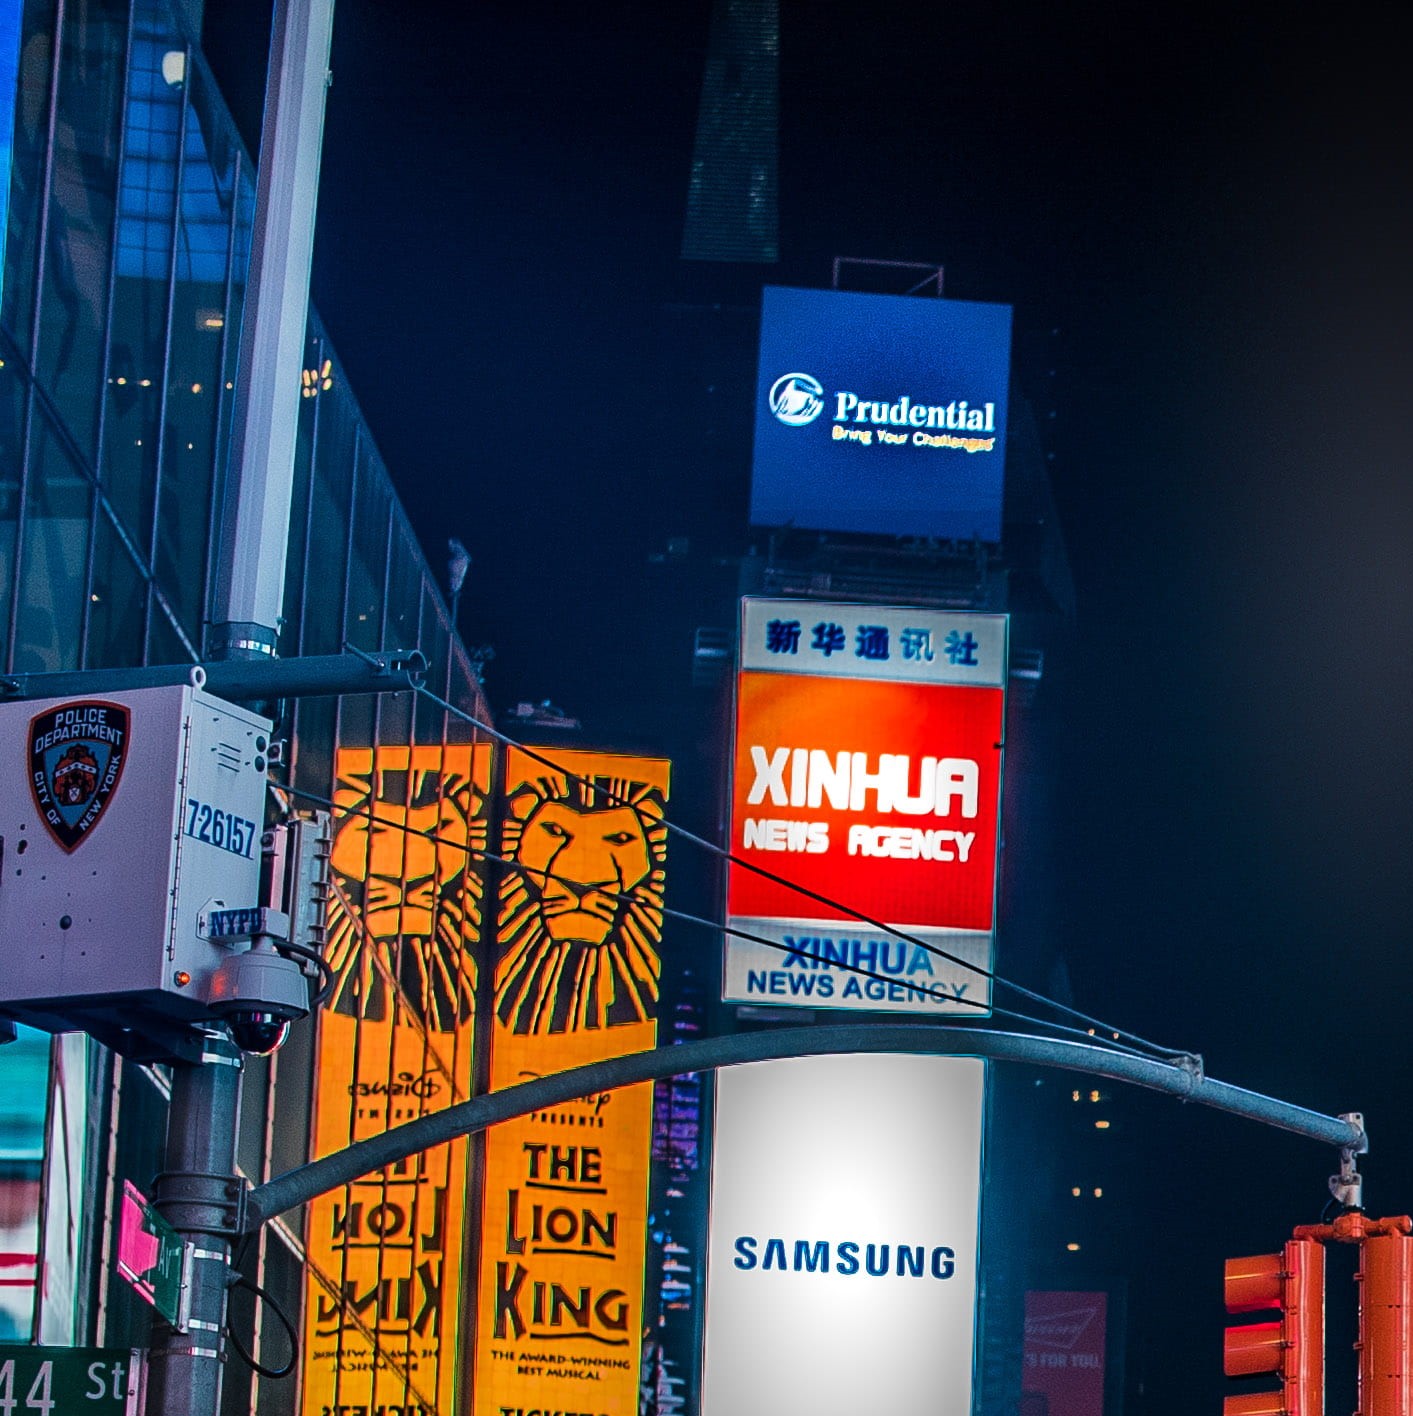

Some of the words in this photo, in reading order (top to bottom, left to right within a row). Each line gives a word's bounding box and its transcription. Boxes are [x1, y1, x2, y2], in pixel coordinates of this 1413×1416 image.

[833, 391, 995, 432] Prudential
[832, 425, 873, 446] Bring
[877, 429, 909, 445] Your
[765, 618, 980, 668] 新华通讯社
[55, 708, 108, 726] POLICE
[35, 722, 123, 754] DEPARTMENT
[34, 771, 50, 804] CITY
[47, 809, 62, 826] OF
[79, 801, 102, 832] NEW
[101, 753, 122, 795] YORK
[747, 745, 980, 819] XINHUA
[742, 817, 830, 856] NEWS
[847, 823, 976, 863] AGENCY
[210, 908, 264, 937] NYPD
[780, 933, 935, 977] XINHUA
[746, 969, 838, 1000] NEWS
[842, 974, 971, 1006] AGENCY
[531, 1112, 604, 1128] PRESENTS
[523, 1142, 602, 1183] THE
[506, 1189, 617, 1256] LION
[733, 1235, 957, 1281] SAMSUNG
[492, 1260, 630, 1340] KING
[491, 1349, 516, 1362] THE
[519, 1351, 631, 1370] AWARD-WINNING
[517, 1366, 544, 1377] BEST
[546, 1367, 601, 1381] MUSICAL
[86, 1361, 125, 1401] St
